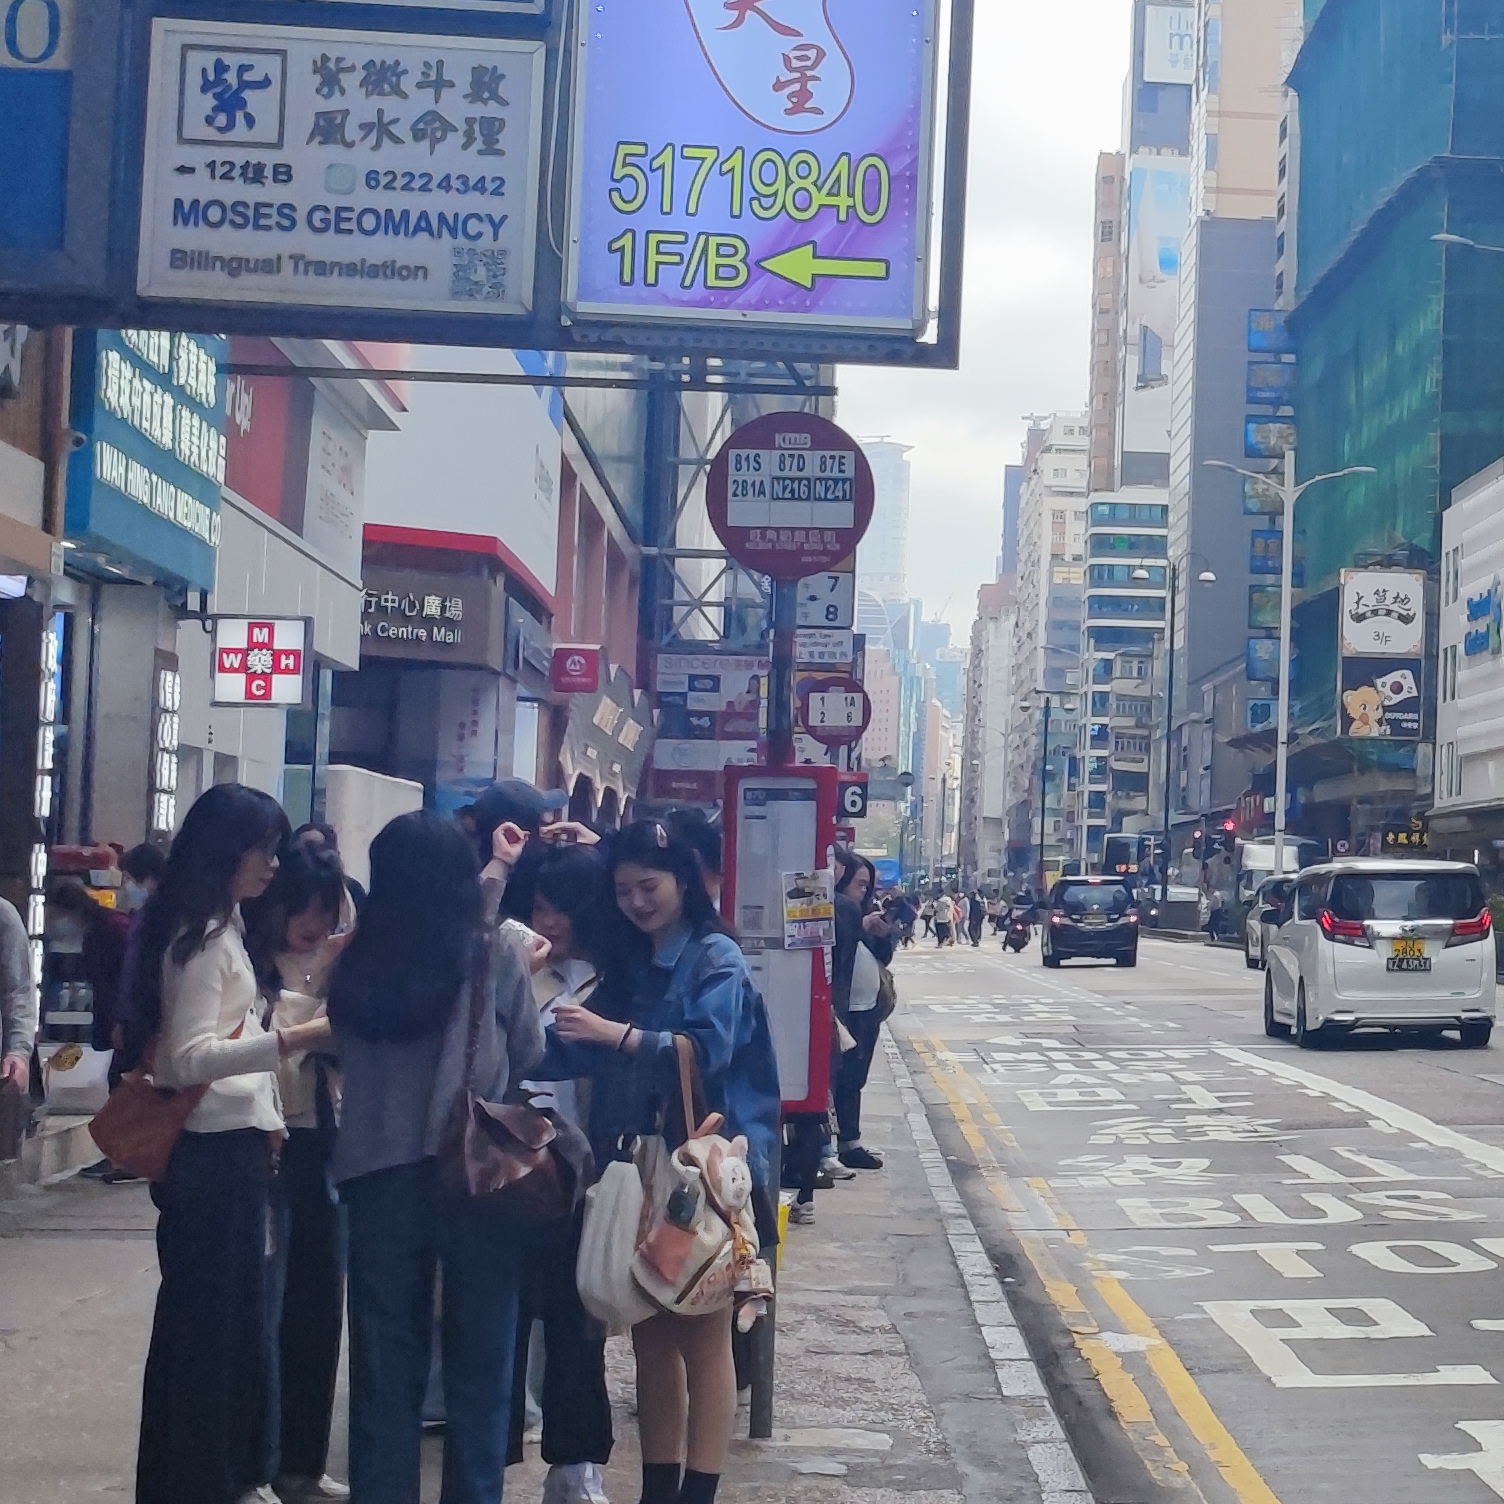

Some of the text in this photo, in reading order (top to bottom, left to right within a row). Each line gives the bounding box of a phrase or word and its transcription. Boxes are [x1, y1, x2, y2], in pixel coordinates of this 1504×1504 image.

[312, 53, 510, 107] 紫微斗數
[200, 57, 272, 134] 紫
[306, 108, 506, 156] 風水命理
[365, 169, 506, 197] 62224342
[608, 141, 891, 229] 51719840
[173, 199, 509, 242] MOSES GEOMANCY
[170, 248, 429, 282] Bilingual Translation
[608, 229, 751, 291] 1F/B
[735, 453, 846, 474] 81S 87D 87E
[731, 479, 851, 500] 281A N216 N241
[827, 576, 840, 593] 7
[825, 604, 839, 622] 8
[253, 628, 269, 643] M
[377, 622, 428, 642] Centre
[432, 626, 462, 644] Mall
[222, 653, 294, 670] W H
[251, 680, 266, 695] C
[844, 785, 864, 814] 6
[1115, 1190, 1488, 1228] BUS
